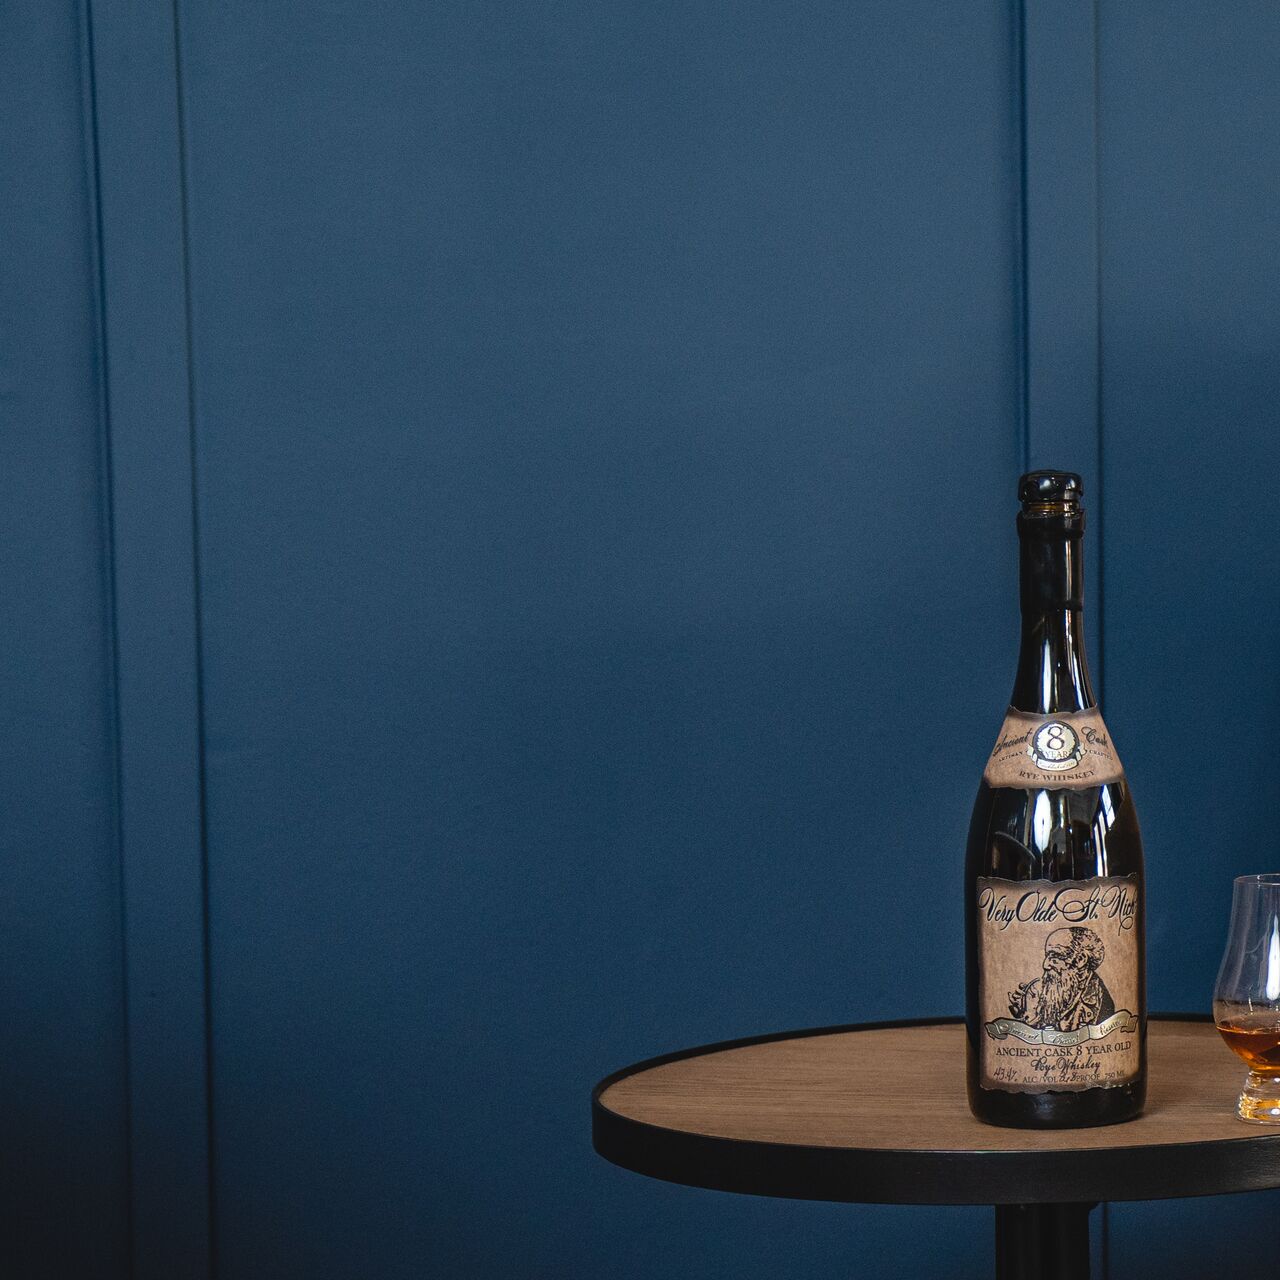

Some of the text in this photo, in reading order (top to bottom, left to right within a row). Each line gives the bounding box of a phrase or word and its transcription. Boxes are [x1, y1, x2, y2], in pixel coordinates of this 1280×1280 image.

[1047, 726, 1065, 750] 8
[1019, 769, 1096, 781] RYE WHISKEY
[978, 886, 1016, 931] Very
[1015, 889, 1057, 923] Olde
[996, 1041, 1131, 1057] ANCIENT CASK 8 YEAR OLD
[1056, 1055, 1101, 1074] Whiskey
[1076, 1072, 1101, 1082] PROOF
